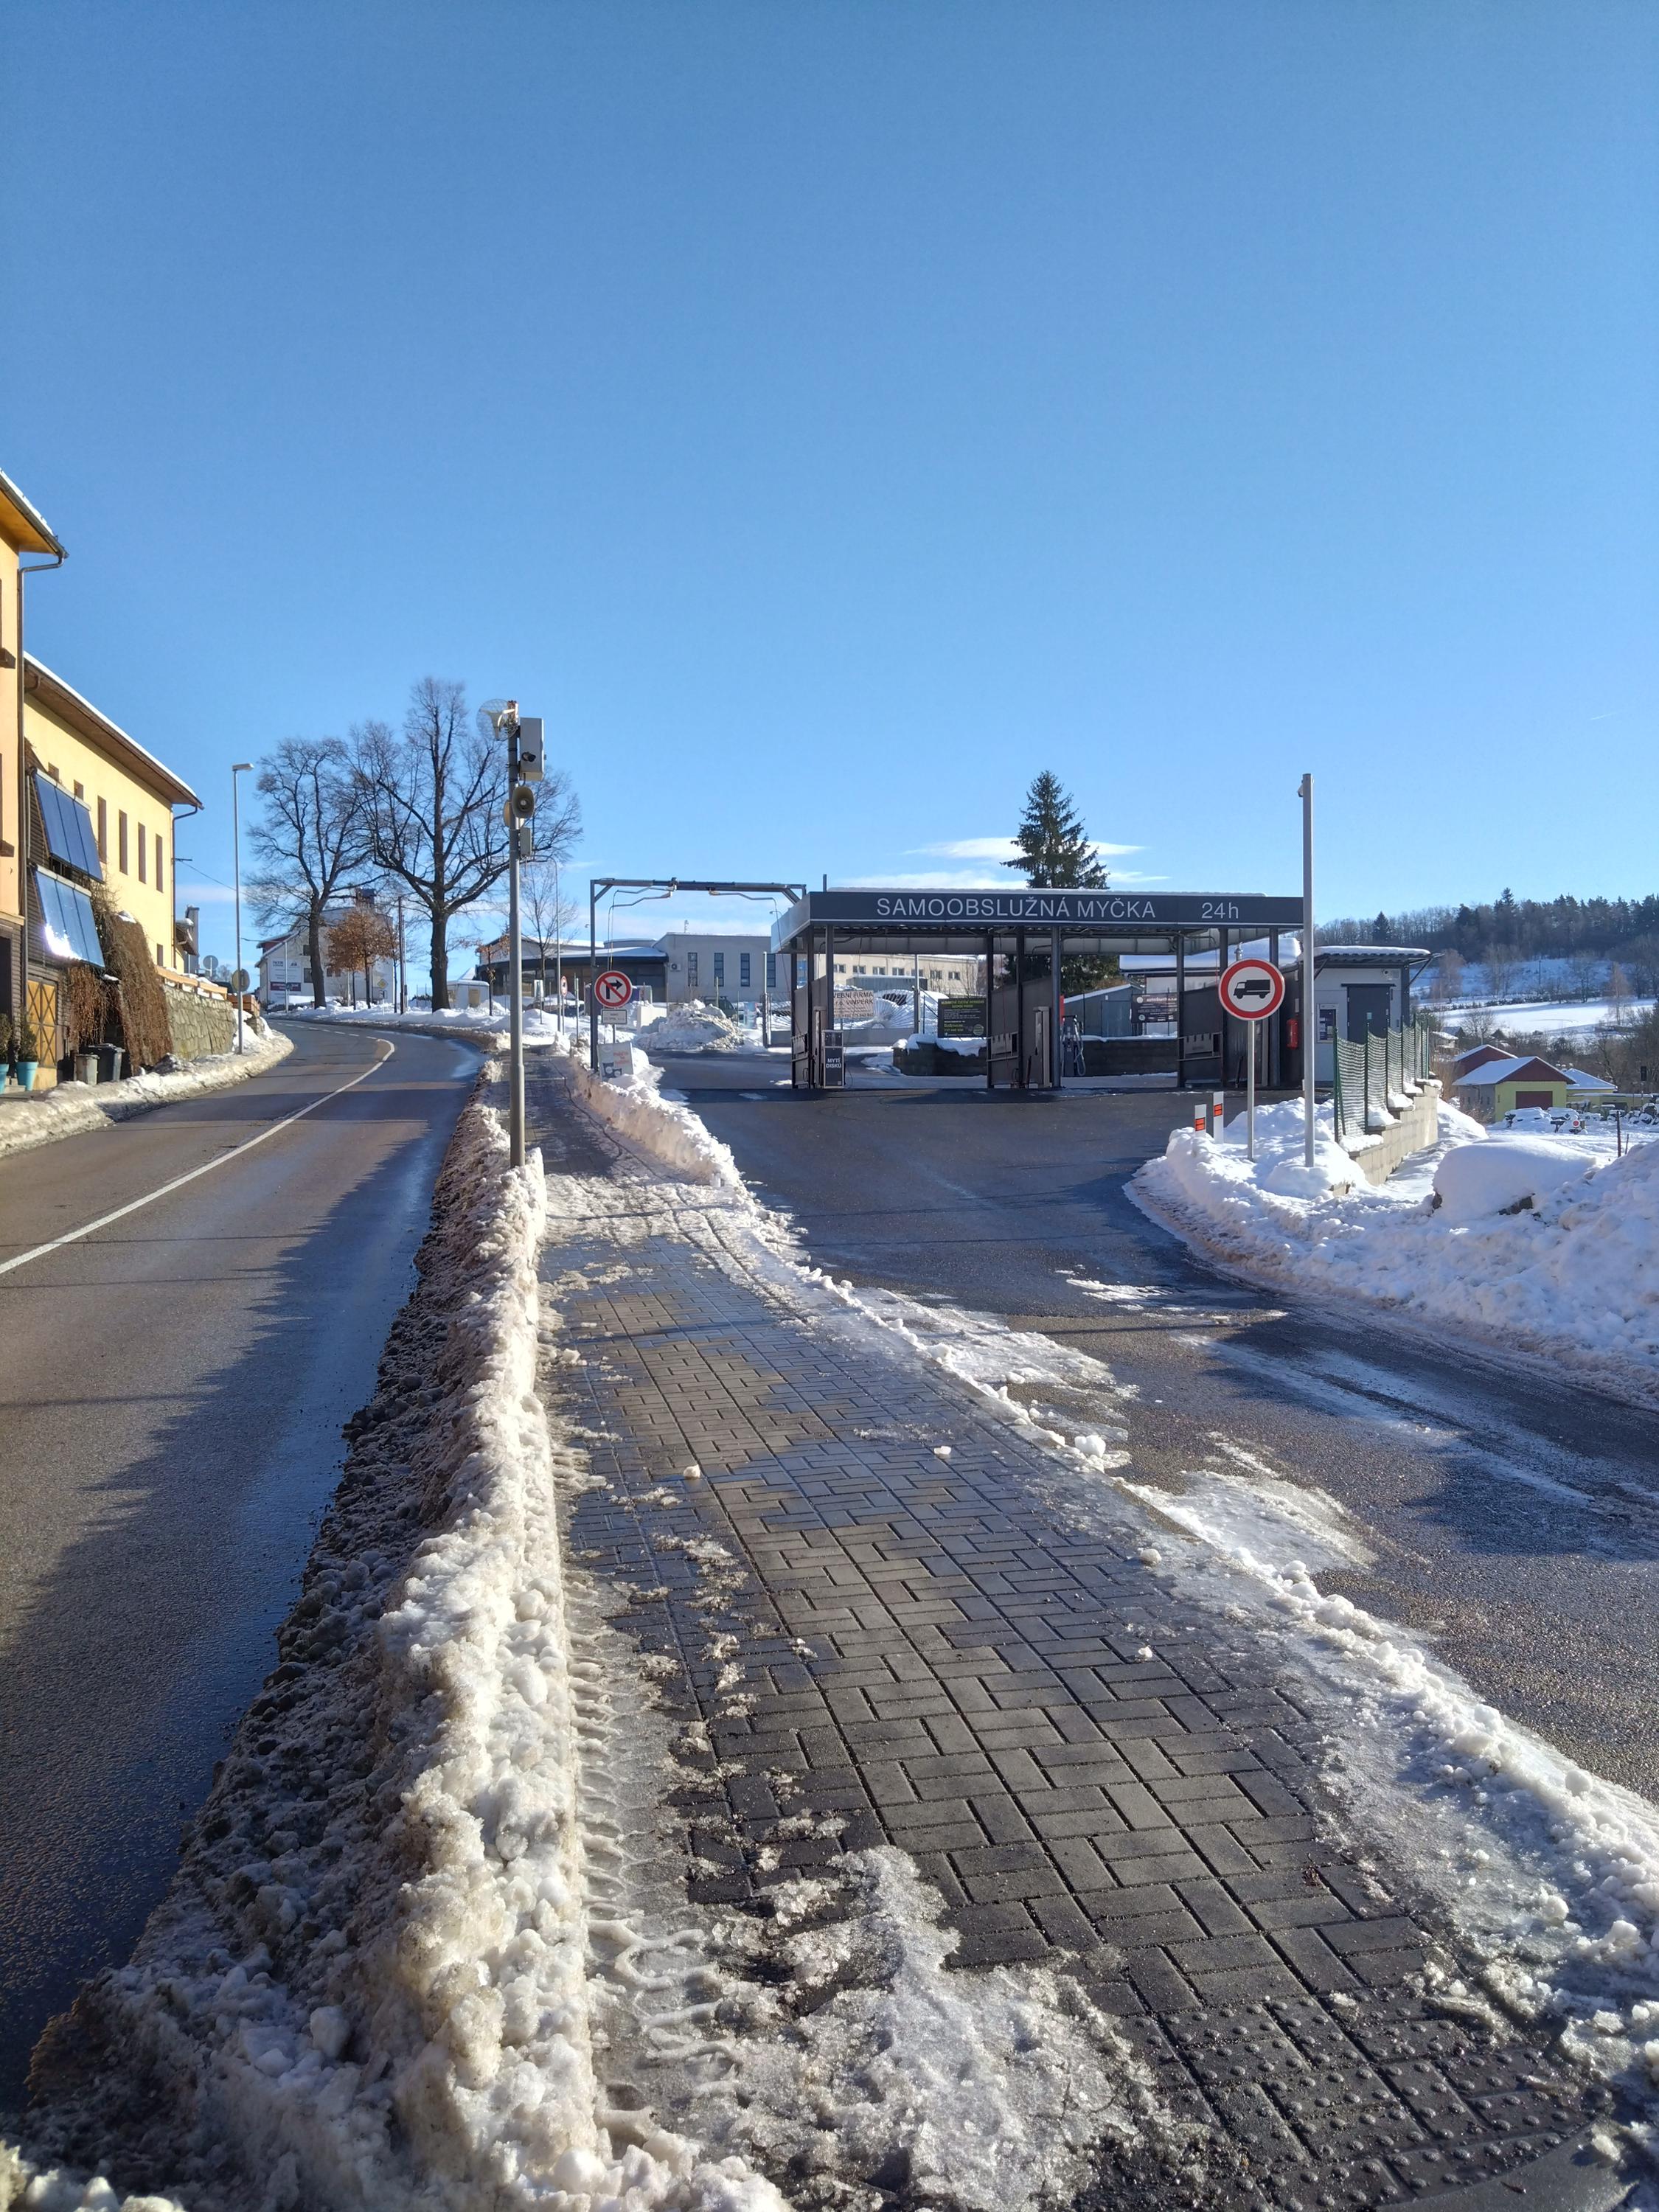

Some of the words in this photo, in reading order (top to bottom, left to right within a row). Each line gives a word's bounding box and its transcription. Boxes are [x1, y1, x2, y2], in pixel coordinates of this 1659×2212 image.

[877, 897, 1070, 917] SAMOOBSLUŽNÁ
[1077, 898, 1156, 918] MYČKA
[1201, 902, 1239, 919] 24h
